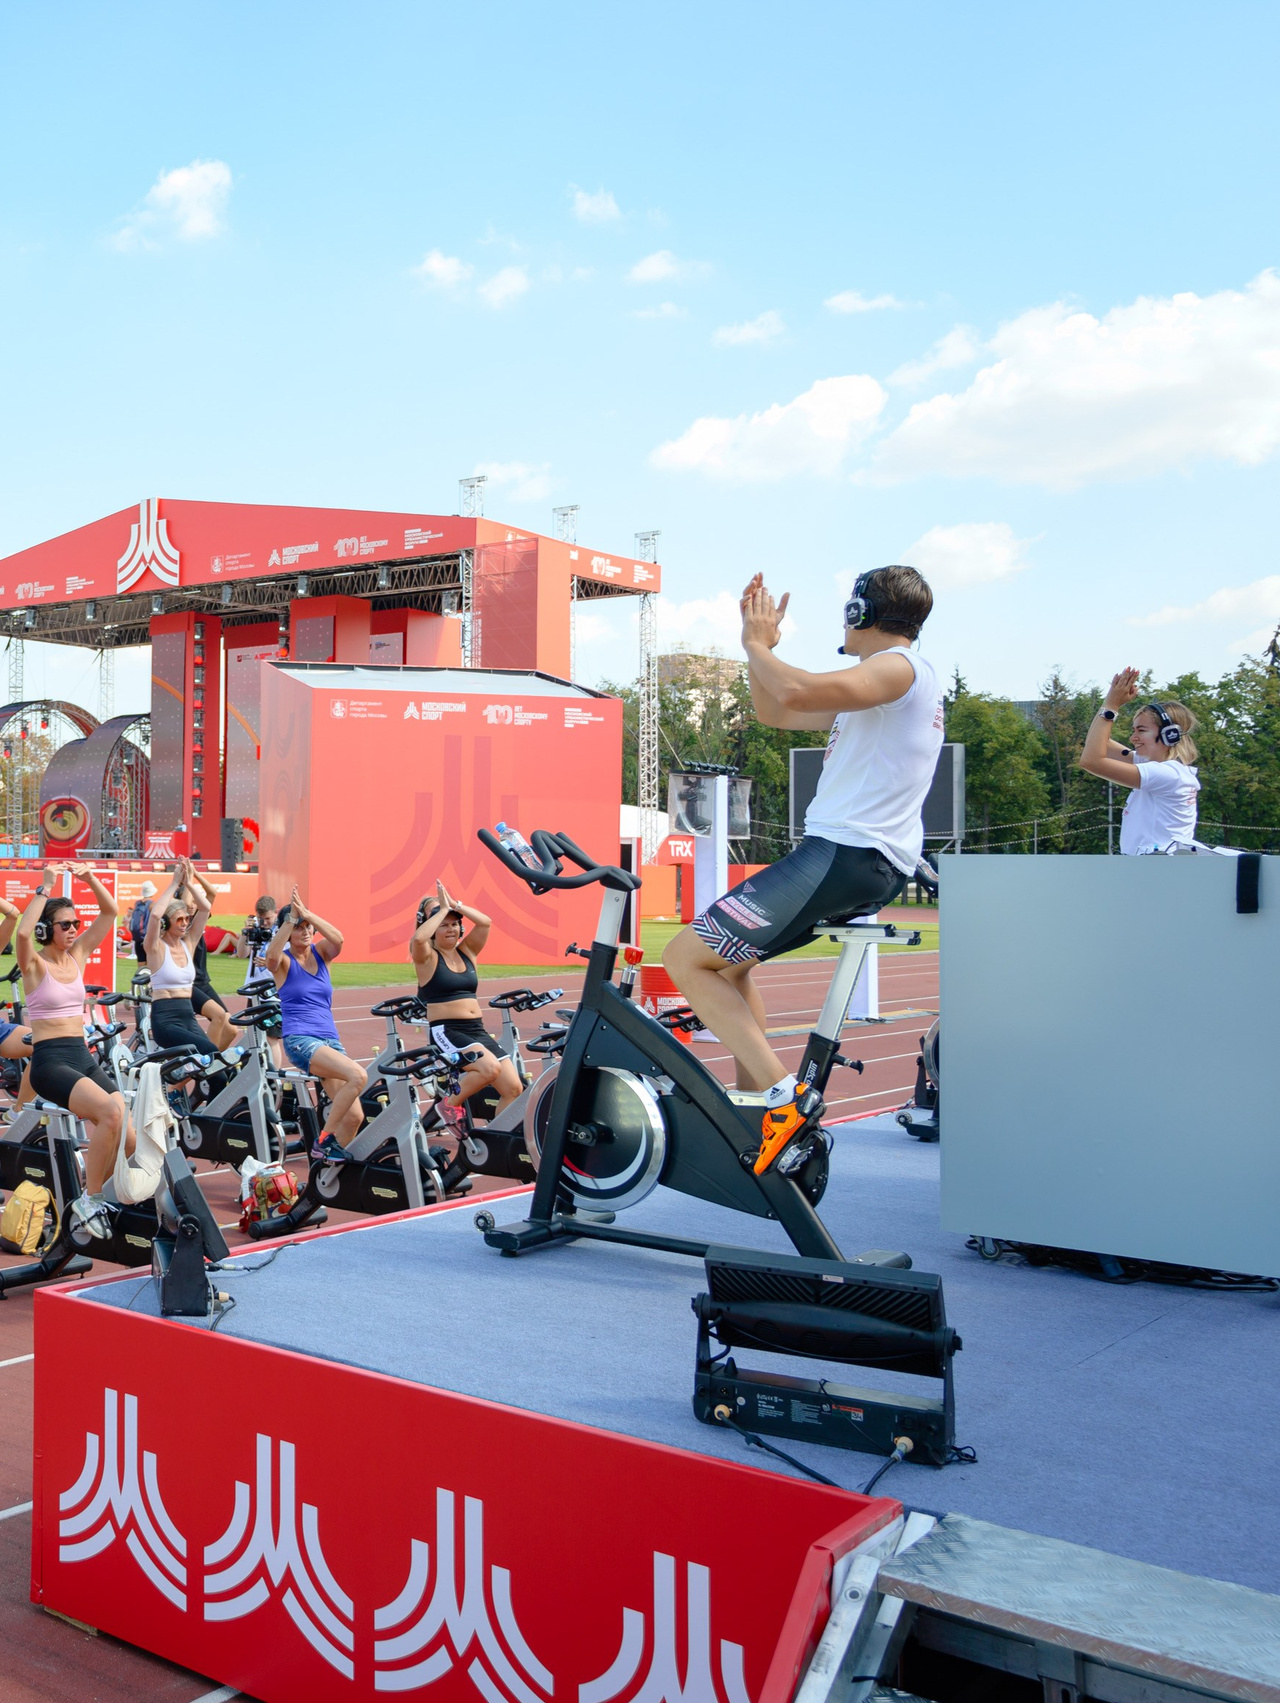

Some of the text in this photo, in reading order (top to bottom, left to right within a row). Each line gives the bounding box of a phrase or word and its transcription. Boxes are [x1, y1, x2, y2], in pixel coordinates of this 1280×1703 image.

[282, 542, 318, 556] МОСКОВСКИЙ
[333, 537, 359, 558] 100
[282, 555, 299, 565] СПОРТ
[422, 702, 466, 712] МОСКОВСКИЙ
[482, 704, 512, 725] 100
[422, 712, 443, 720] СПОРТ
[668, 840, 692, 857] TRX
[728, 898, 754, 918] CYCLE
[739, 894, 766, 916] MUSIC
[718, 900, 754, 929] FESTIVAL
[657, 997, 689, 1006] МОСКОВС
[808, 1062, 818, 1080] Spin
[770, 1089, 786, 1100] adidas
